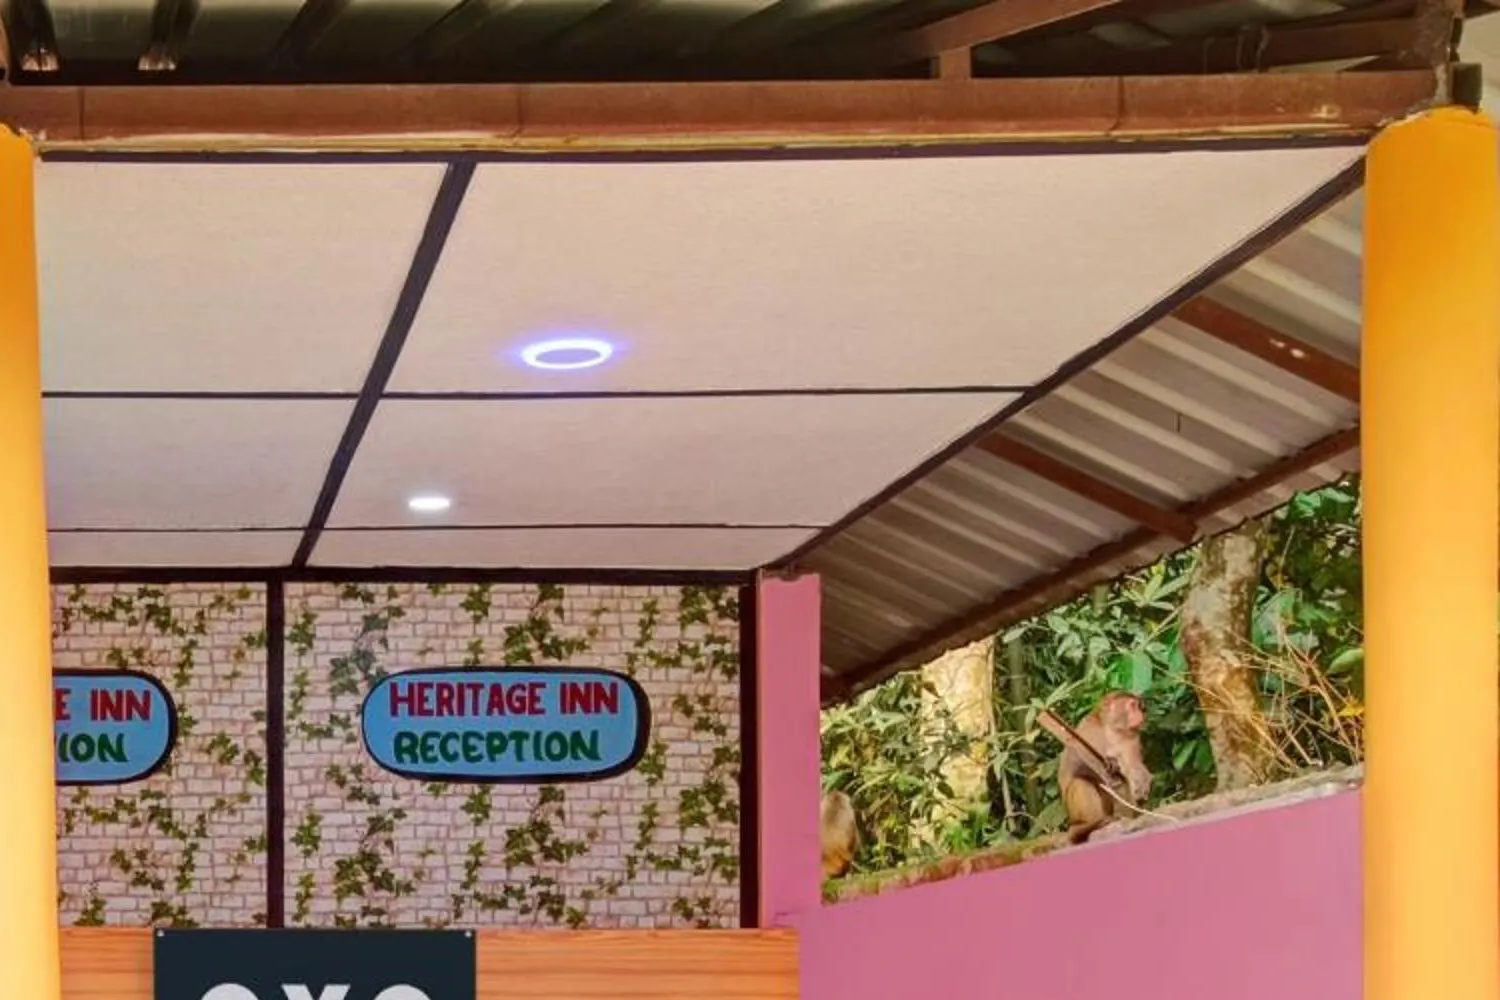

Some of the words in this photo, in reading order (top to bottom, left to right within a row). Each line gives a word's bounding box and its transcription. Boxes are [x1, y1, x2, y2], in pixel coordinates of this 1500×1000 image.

[89, 688, 153, 722] INN
[388, 681, 547, 717] HERITAGE
[559, 681, 620, 714] INN
[393, 729, 602, 765] RECEPTION
